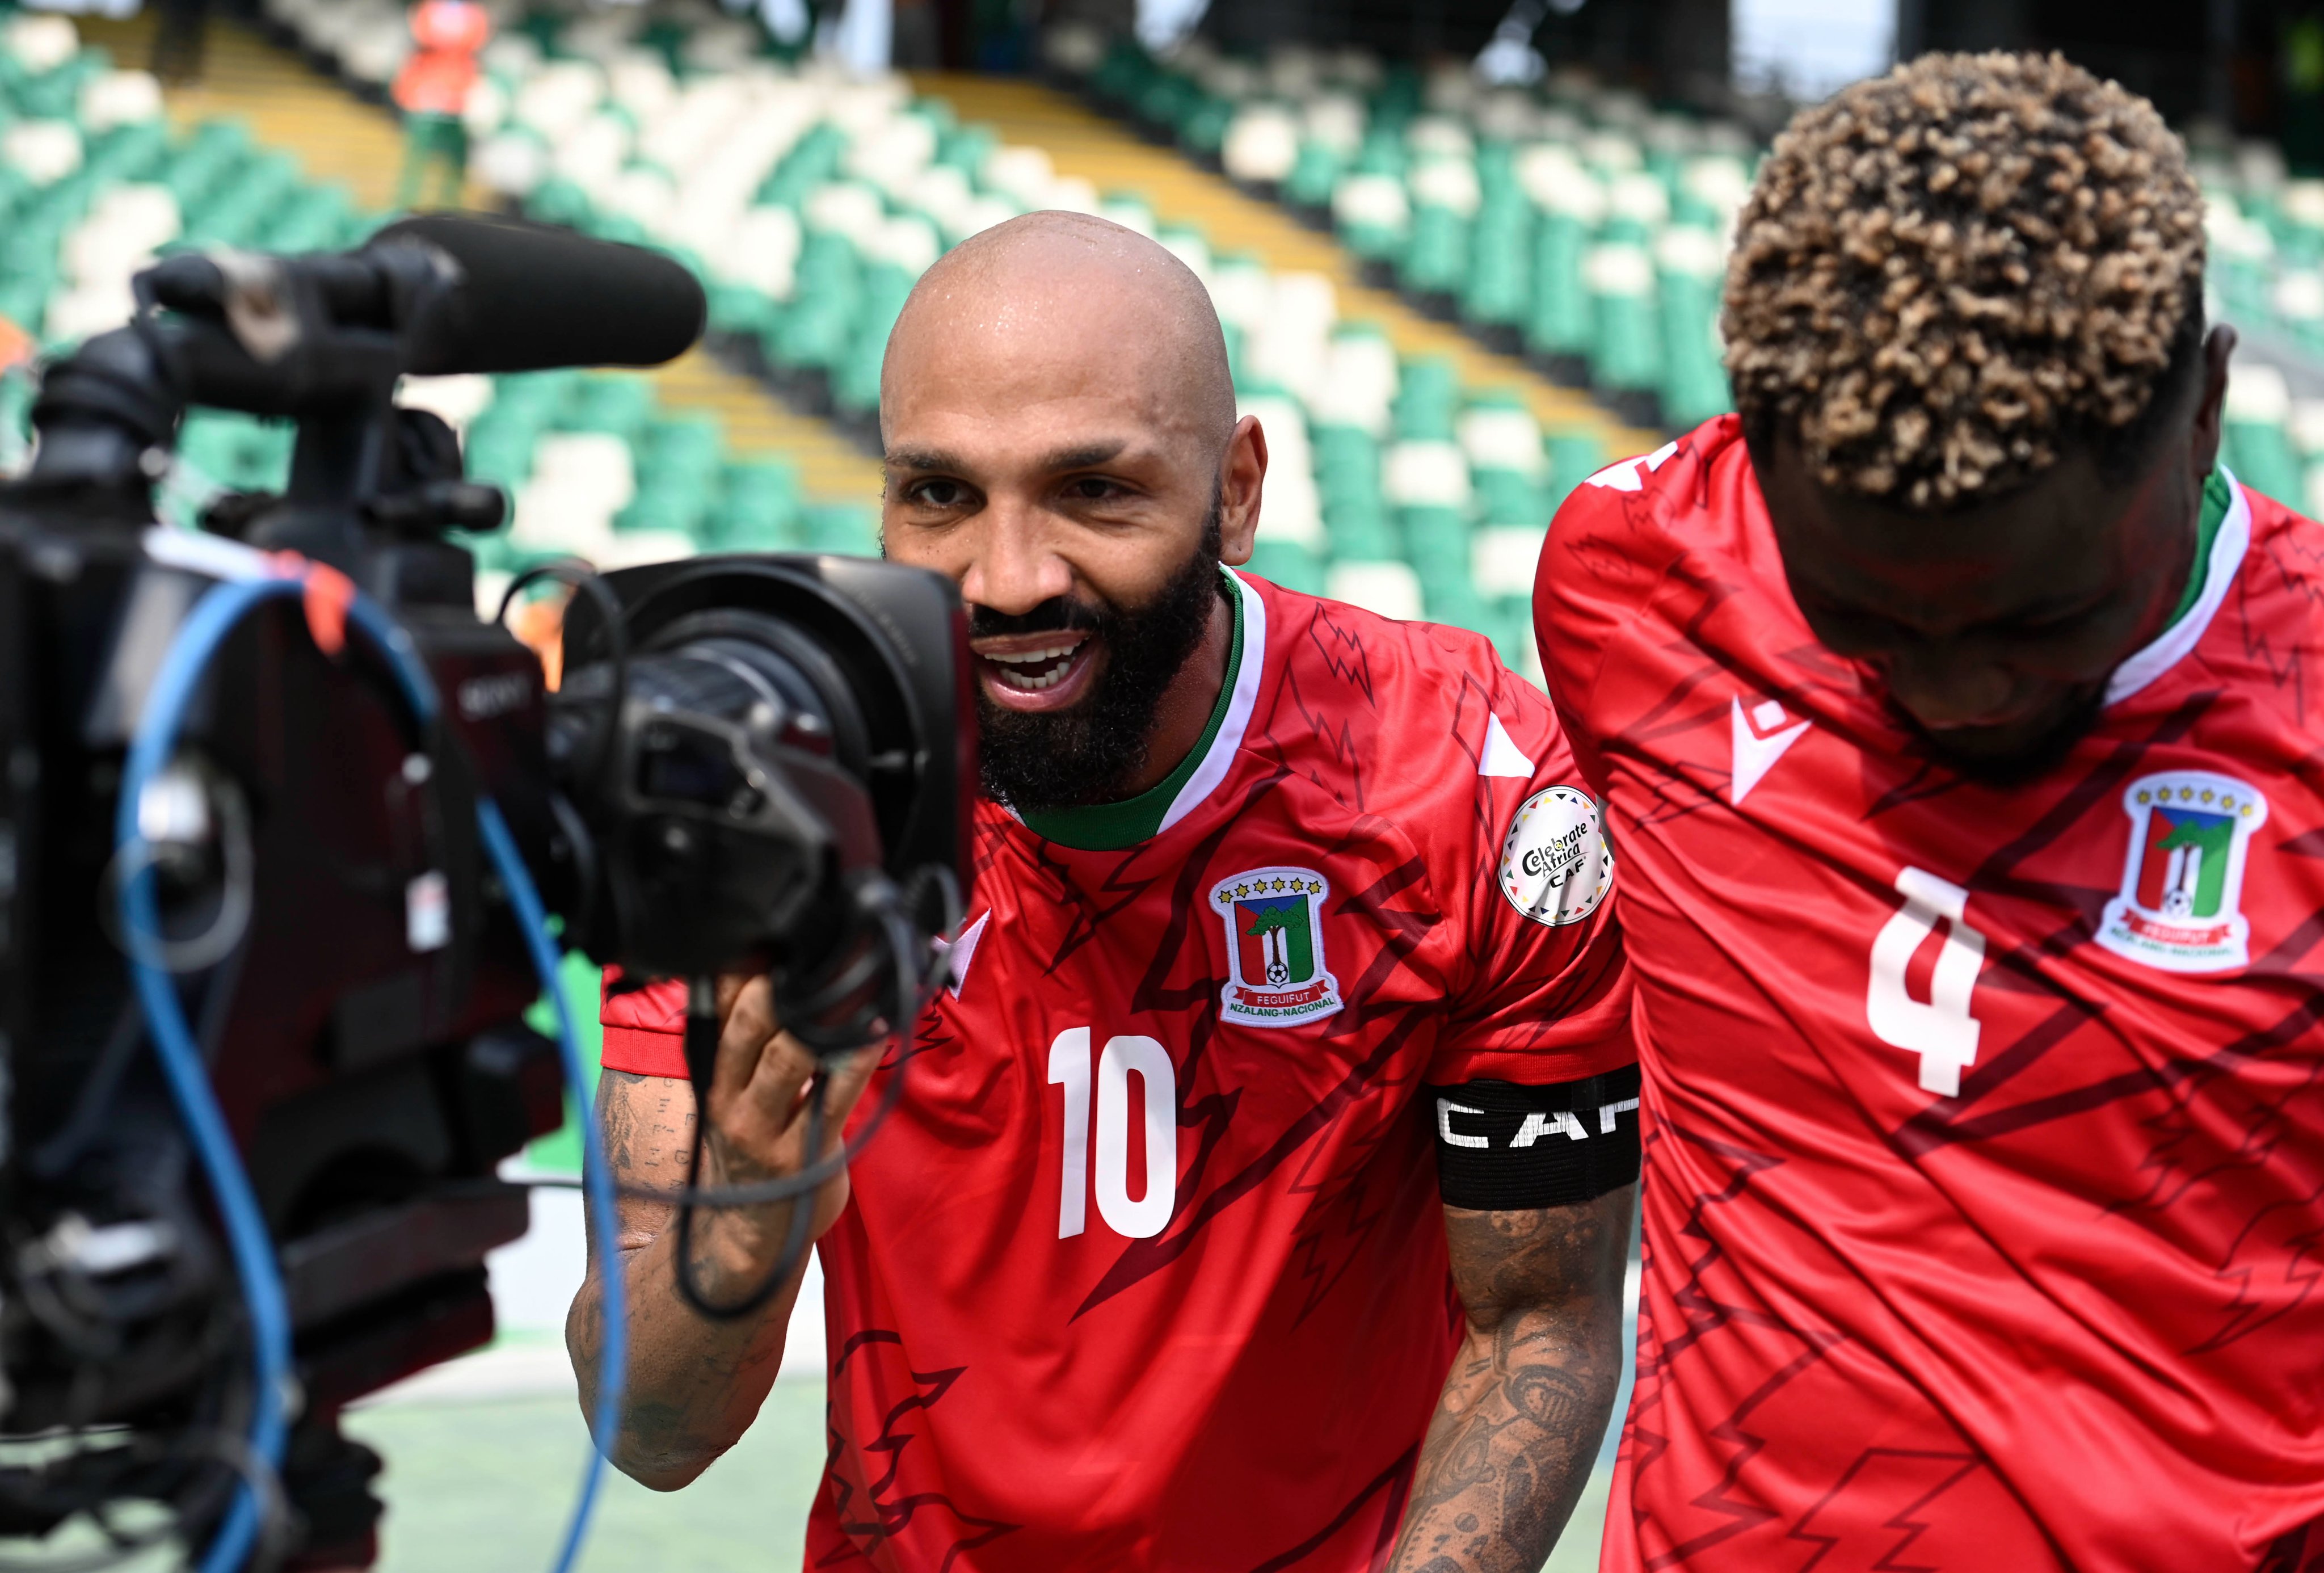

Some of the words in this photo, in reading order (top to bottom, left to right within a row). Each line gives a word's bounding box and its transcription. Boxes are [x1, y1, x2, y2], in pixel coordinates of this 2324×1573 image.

[1522, 823, 1588, 876] Celebrate
[1543, 843, 1581, 878] Africa
[1550, 859, 1584, 888] CAF
[1257, 992, 1310, 1004] FEGUIFUT
[1866, 865, 1986, 1098] 4
[1230, 997, 1335, 1017] NZALANG-NACIONAL
[1048, 1026, 1177, 1240] 10
